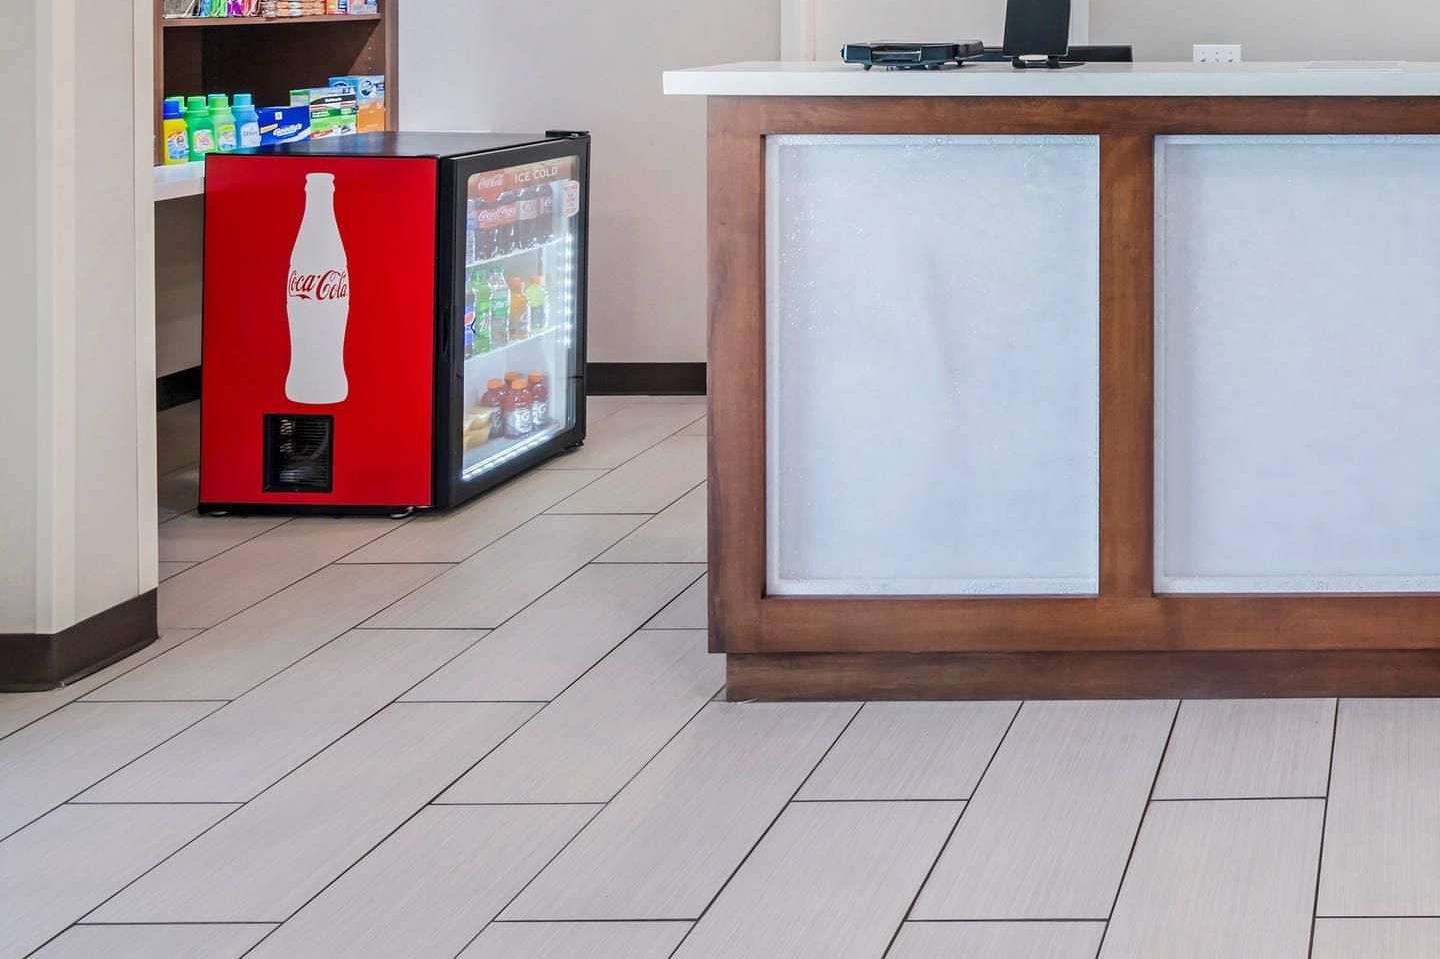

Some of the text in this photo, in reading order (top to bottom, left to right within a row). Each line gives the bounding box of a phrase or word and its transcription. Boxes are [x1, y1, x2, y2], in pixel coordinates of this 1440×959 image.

[514, 171, 531, 183] ICE
[533, 166, 559, 179] COLD
[288, 269, 348, 301] Coca-Cola
